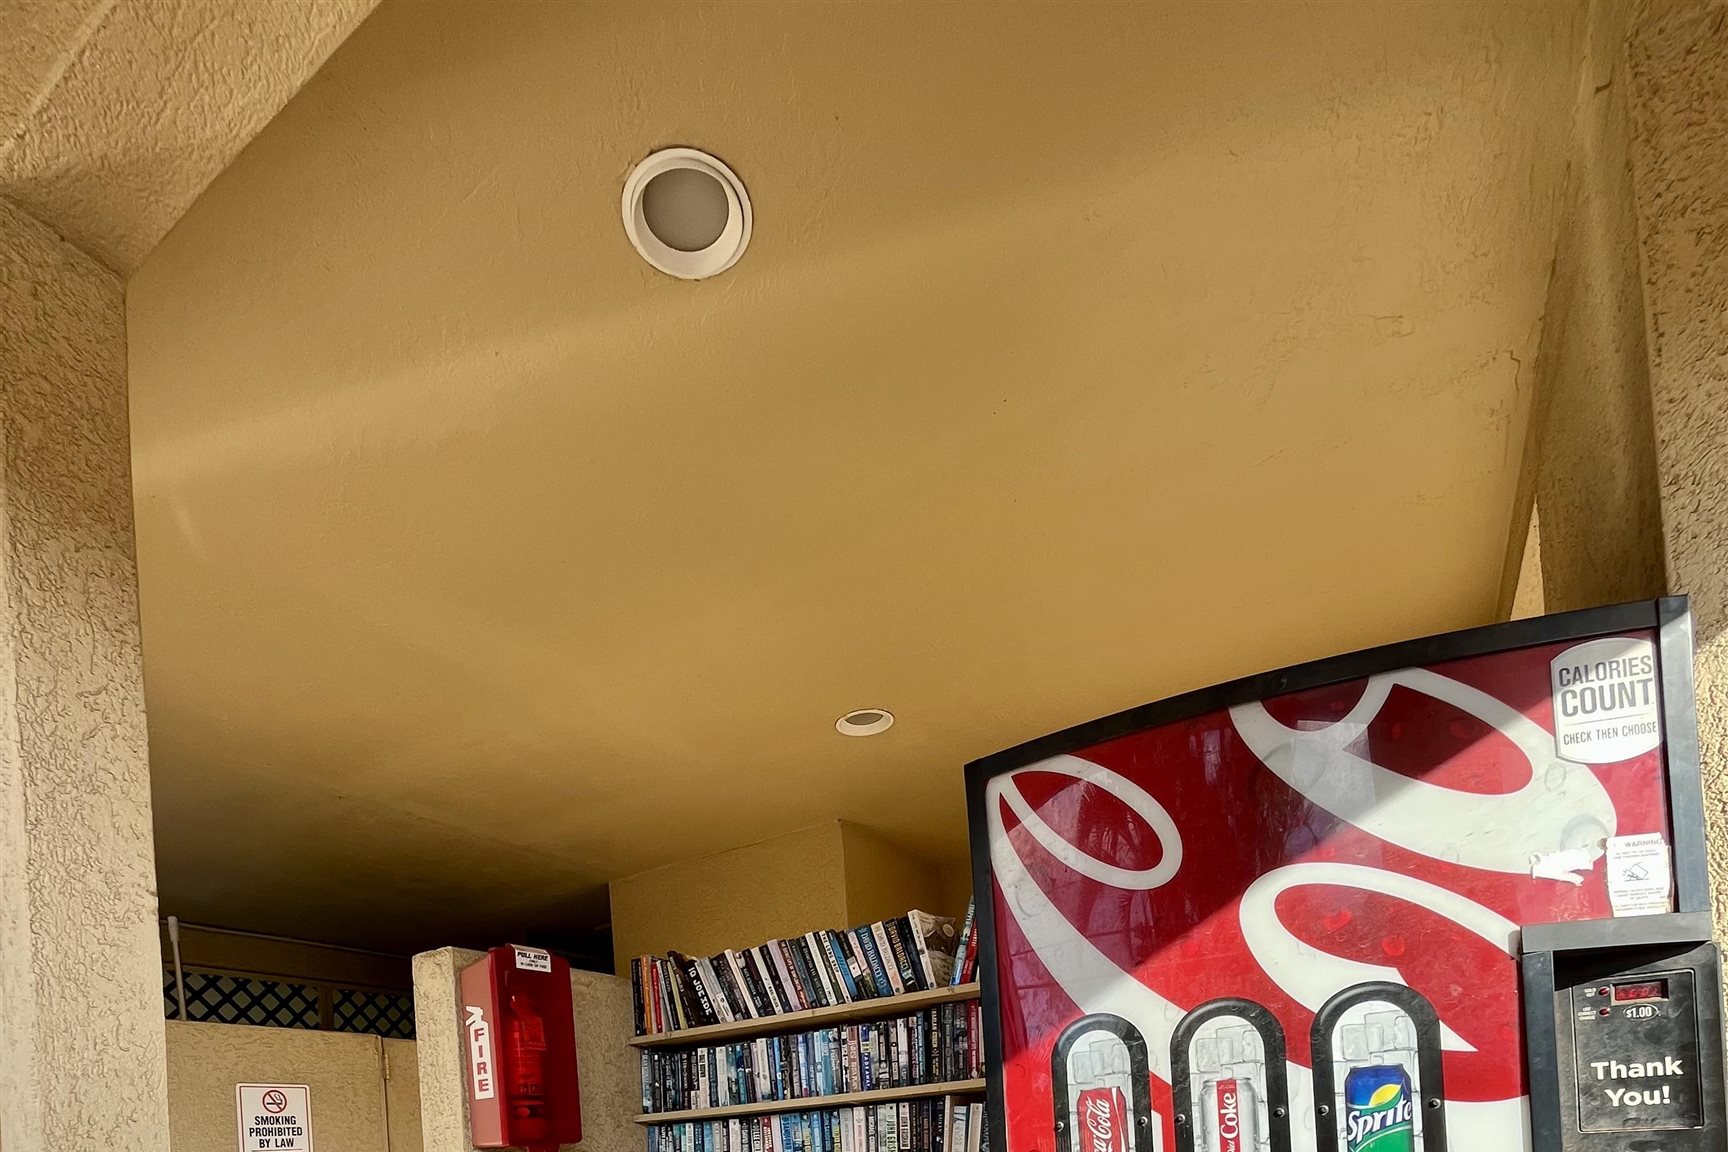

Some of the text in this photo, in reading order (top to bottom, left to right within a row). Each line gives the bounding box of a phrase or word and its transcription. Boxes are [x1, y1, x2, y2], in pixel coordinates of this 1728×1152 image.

[1558, 655, 1652, 687] CALORIES
[1560, 678, 1653, 717] COUNT
[1563, 720, 1657, 746] CHECK THEN CHOOSE
[1624, 839, 1662, 848] WARNING
[826, 945, 834, 959] LONG
[832, 960, 840, 974] DROP
[861, 934, 882, 978] DAVID BALDACCI
[889, 926, 909, 970] DAVID BALDACCI
[1626, 1006, 1652, 1019] $1.00
[473, 1027, 490, 1093] FIRE
[1590, 1056, 1683, 1080] Thank
[1604, 1085, 1671, 1107] You!
[254, 1115, 297, 1126] SMOKING
[887, 1120, 895, 1135] JOHN
[1220, 1092, 1239, 1139] Coke
[1348, 1098, 1412, 1147] Sprite
[249, 1126, 303, 1137] PROHIBITED
[259, 1138, 294, 1148] BY LAW
